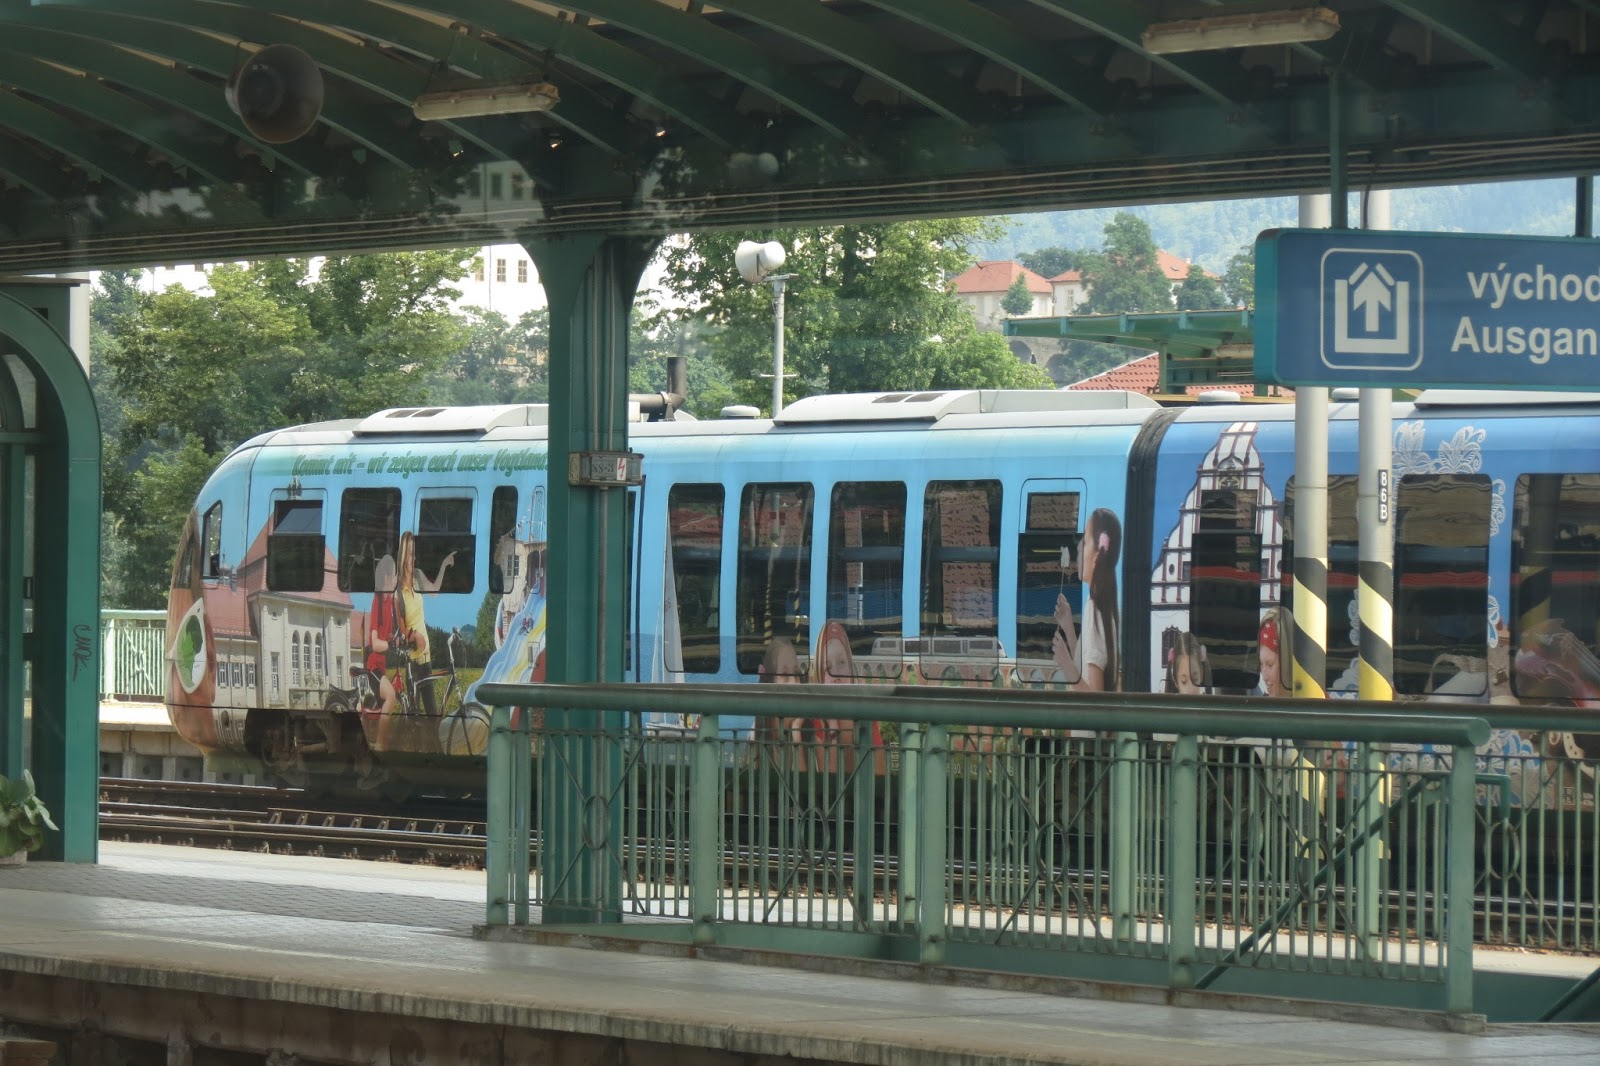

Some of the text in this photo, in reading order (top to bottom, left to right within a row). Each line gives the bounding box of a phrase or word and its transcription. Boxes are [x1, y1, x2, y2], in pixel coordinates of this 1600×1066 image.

[1467, 262, 1600, 309] východ
[1450, 316, 1598, 365] Ausgan
[292, 454, 334, 476] Kommt
[333, 452, 357, 475] mit
[367, 451, 389, 474] wir
[387, 450, 429, 479] zeigen
[427, 449, 459, 472] euch
[457, 453, 494, 472] unser
